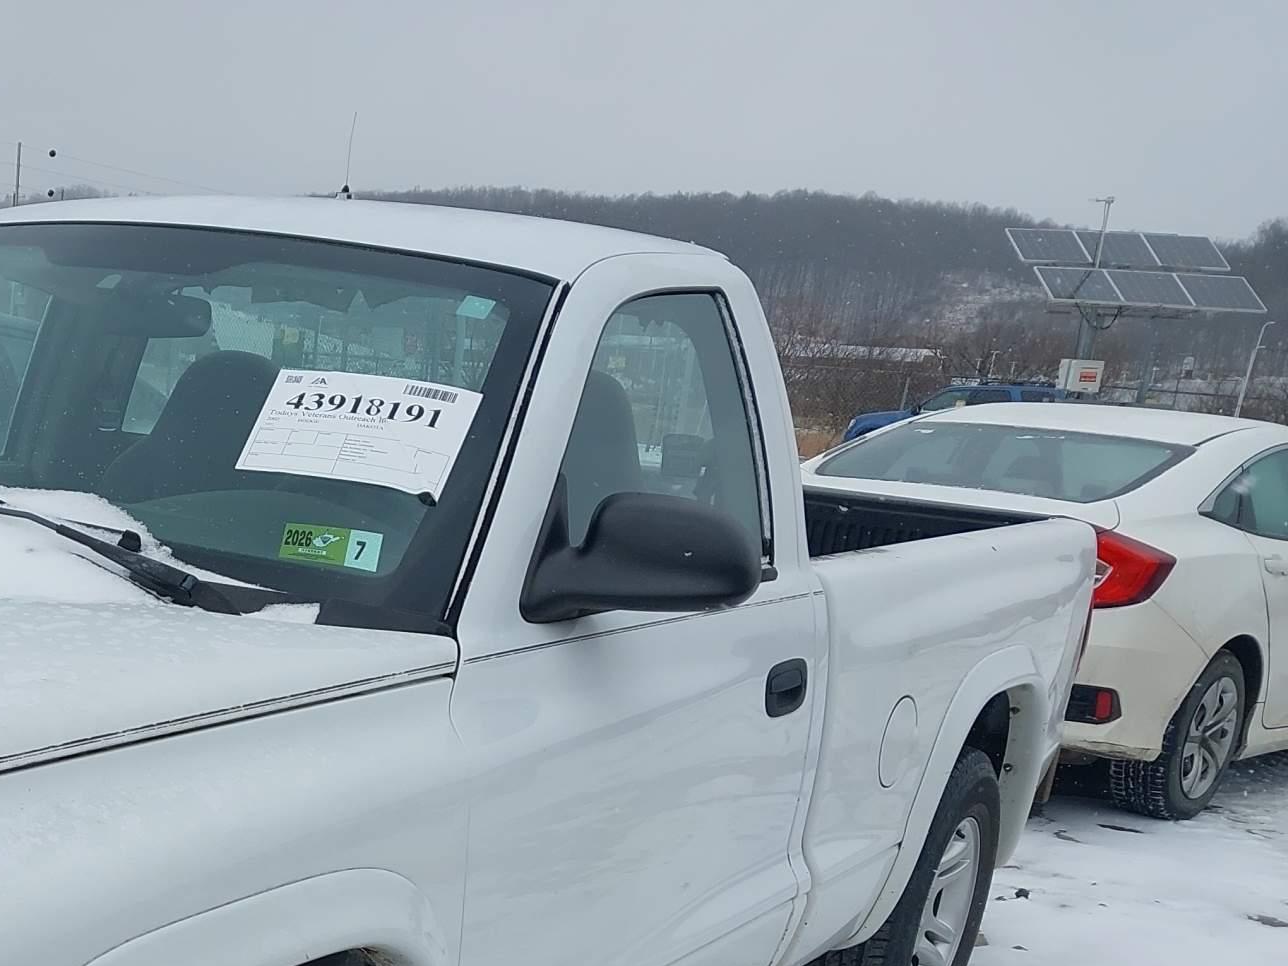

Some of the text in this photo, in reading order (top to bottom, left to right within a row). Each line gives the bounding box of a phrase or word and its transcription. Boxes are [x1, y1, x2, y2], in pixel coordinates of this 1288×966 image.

[286, 391, 443, 429] 43918191
[302, 410, 336, 420] Veterans
[339, 414, 376, 423] Outreach
[283, 529, 313, 547] 2026
[355, 541, 367, 560] 7
